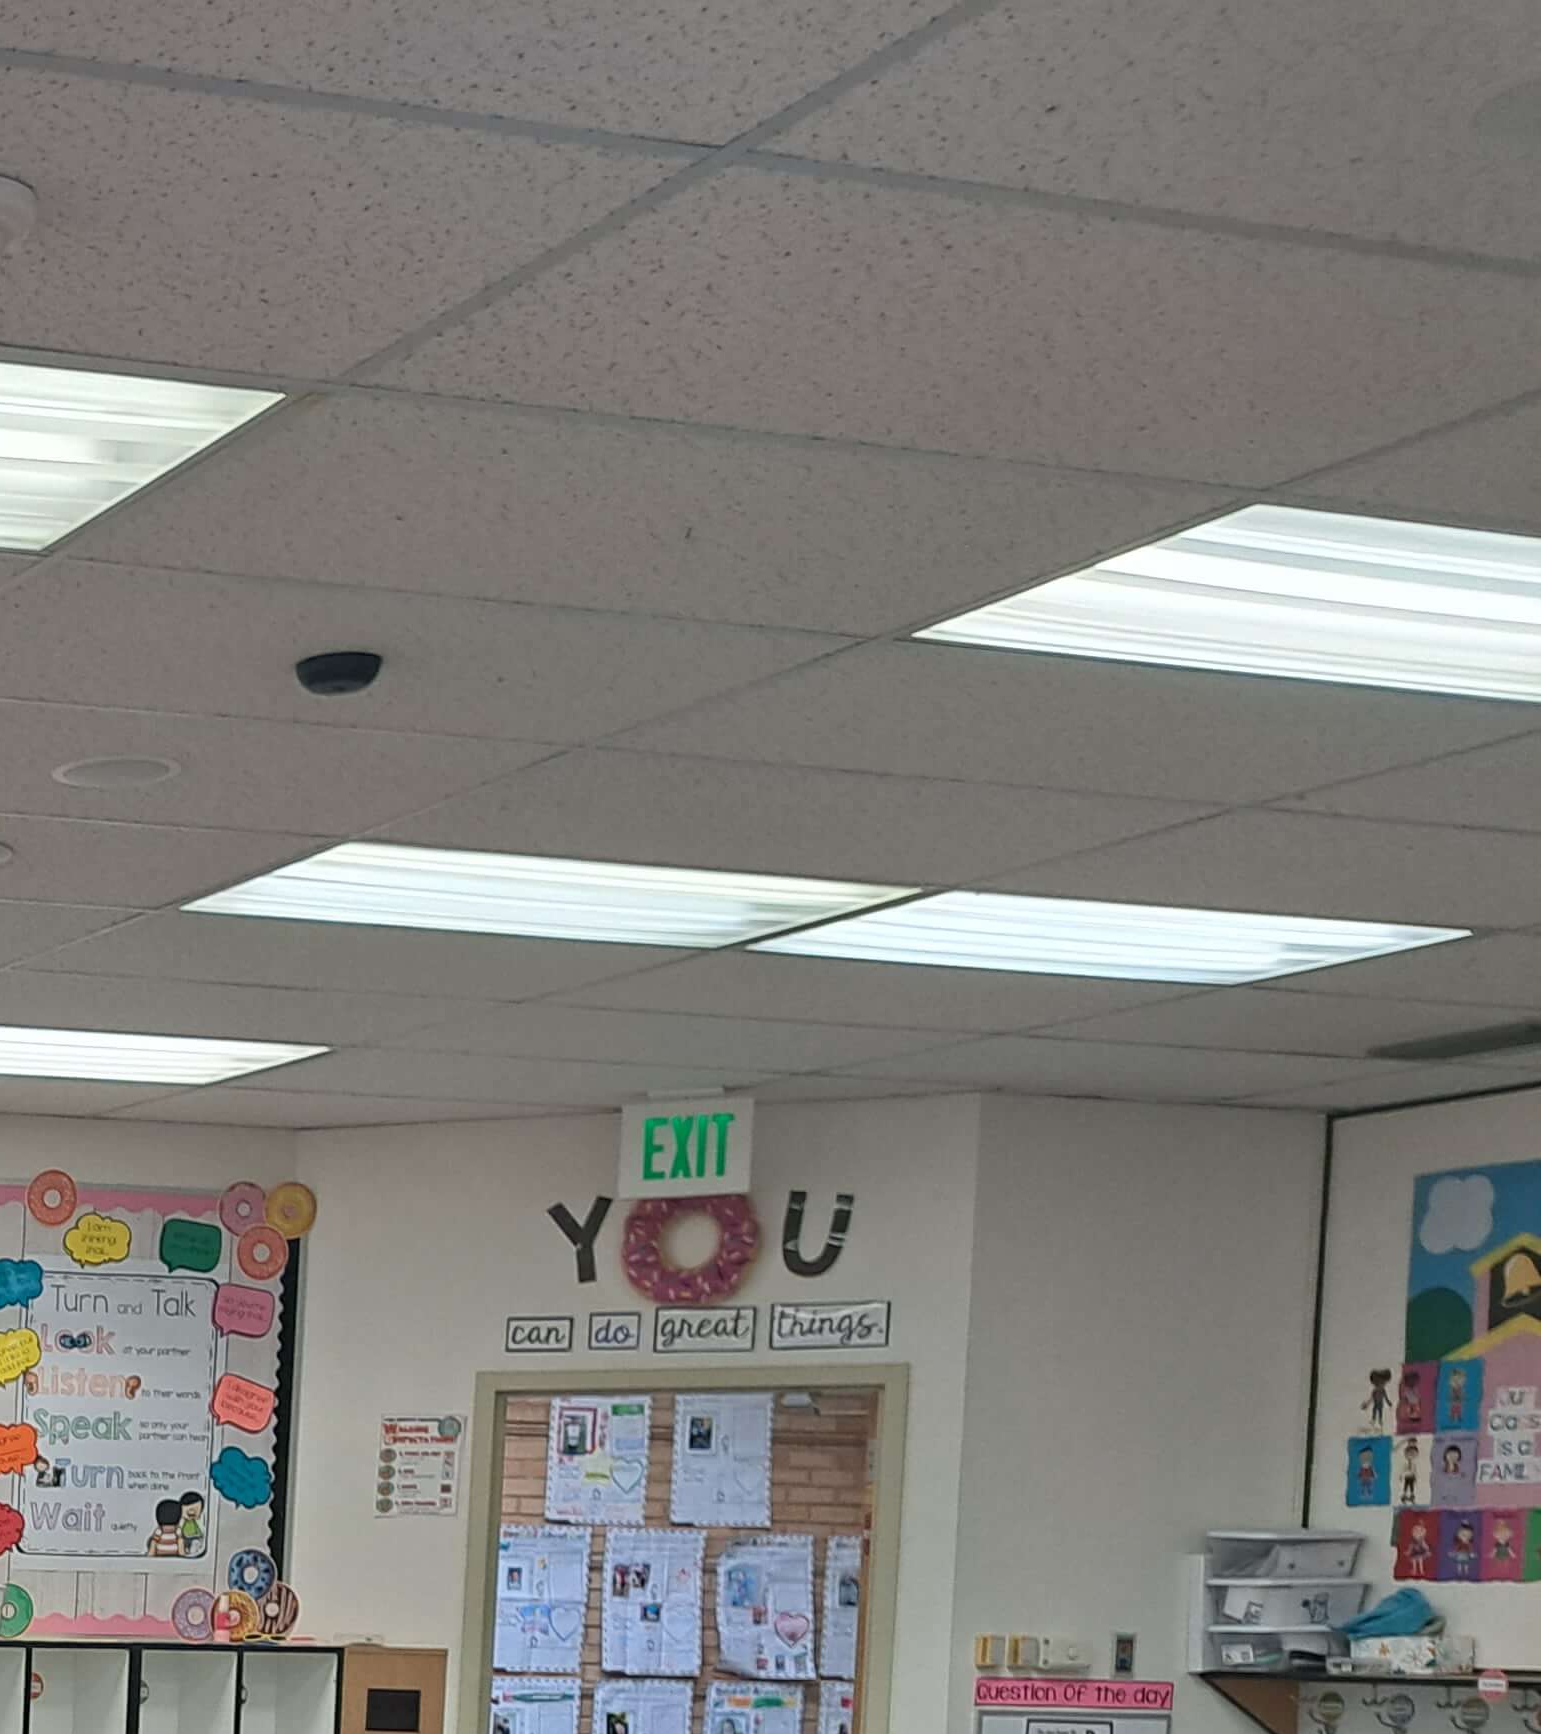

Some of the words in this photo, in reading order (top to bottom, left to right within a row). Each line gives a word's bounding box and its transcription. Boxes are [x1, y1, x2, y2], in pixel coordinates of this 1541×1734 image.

[642, 1113, 734, 1181] EXIT
[51, 1284, 109, 1313] Turn
[117, 1303, 143, 1316] and
[151, 1288, 197, 1318] Talk
[40, 1323, 117, 1355] Look
[510, 1323, 567, 1346] can
[594, 1323, 634, 1344] do
[660, 1307, 750, 1343] great
[775, 1307, 885, 1343] things.
[136, 1347, 155, 1357] your
[157, 1347, 190, 1357] partner
[37, 1366, 127, 1398] Listen
[33, 1408, 132, 1445] Speak
[52, 1458, 124, 1488] Turn
[30, 1502, 105, 1531] Wait
[977, 1685, 1056, 1702] Question
[1095, 1686, 1126, 1702] the
[1133, 1689, 1169, 1706] day
